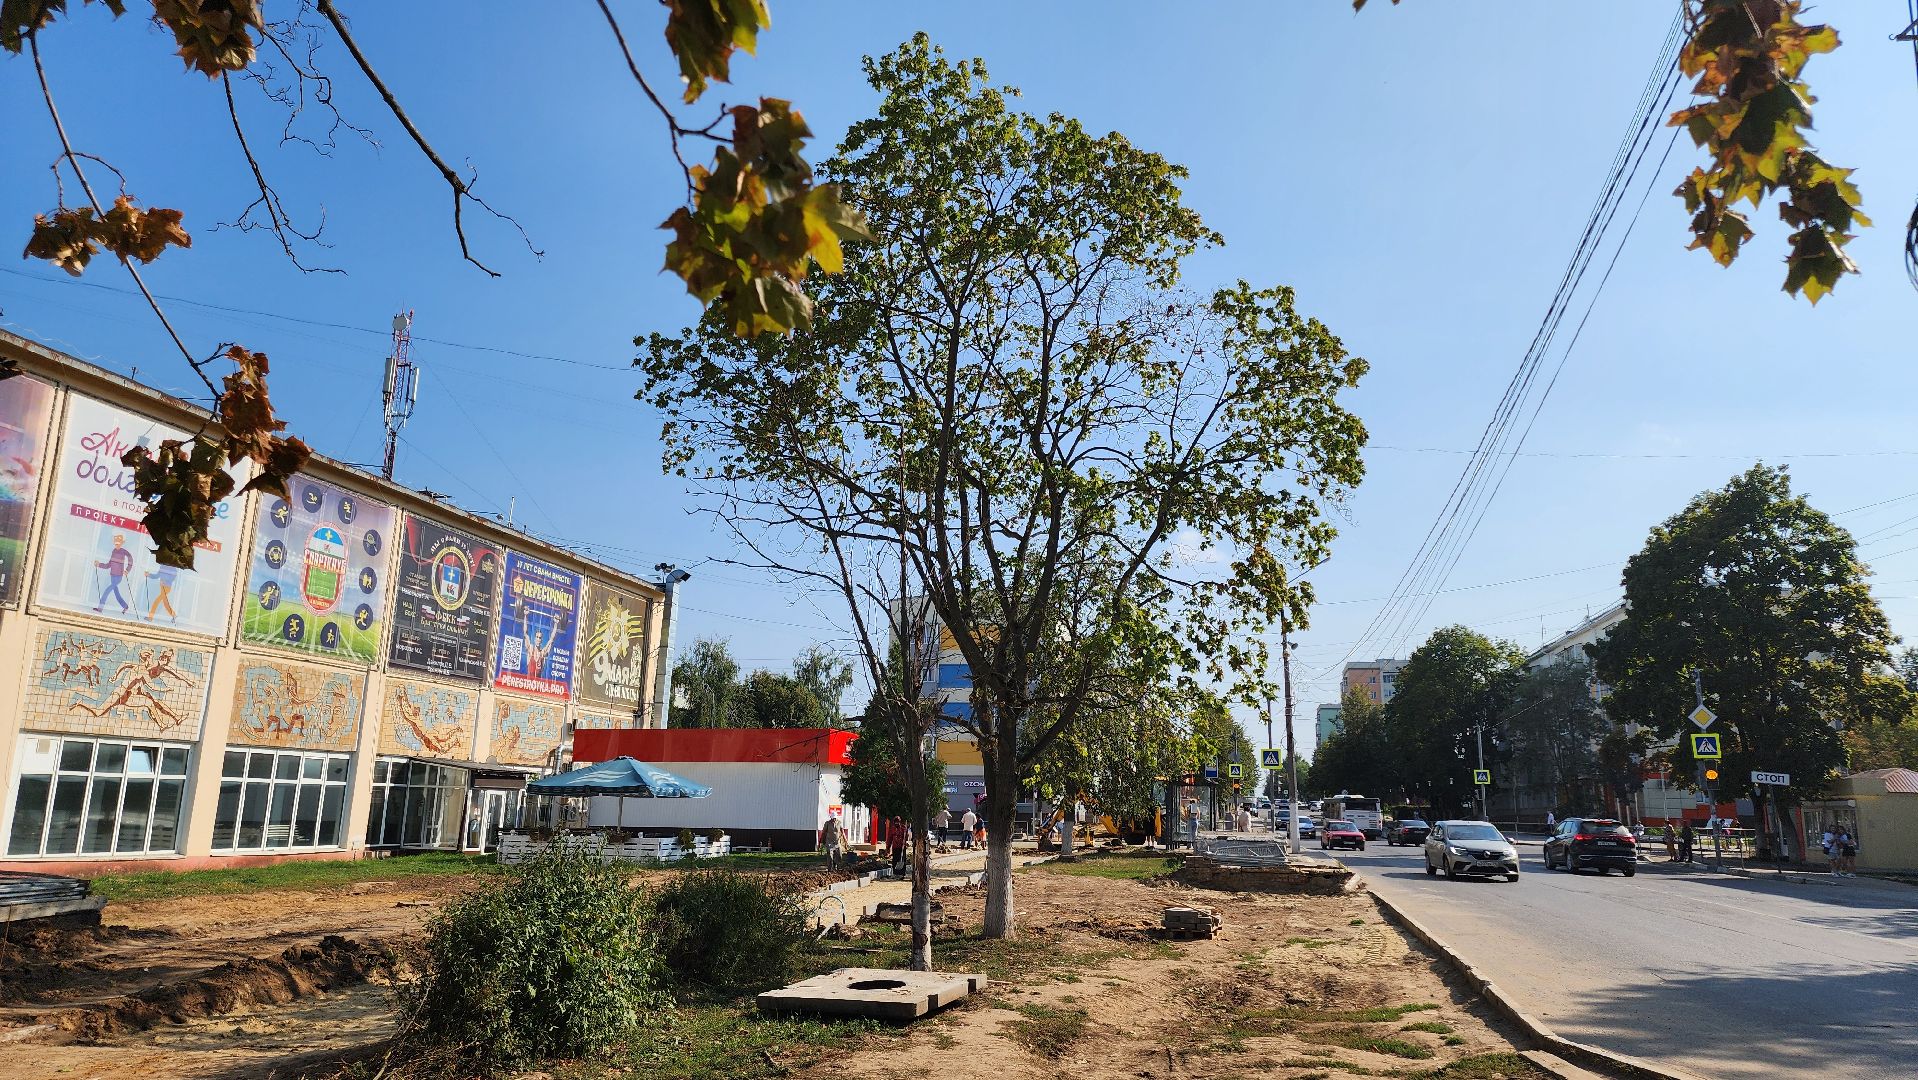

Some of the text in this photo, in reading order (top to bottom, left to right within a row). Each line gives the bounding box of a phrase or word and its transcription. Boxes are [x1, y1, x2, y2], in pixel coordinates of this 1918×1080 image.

[75, 506, 126, 526] ПРОЕКТ
[523, 579, 573, 611] ПЕРЕСТРОЙКА
[1756, 773, 1785, 784] СТОП
